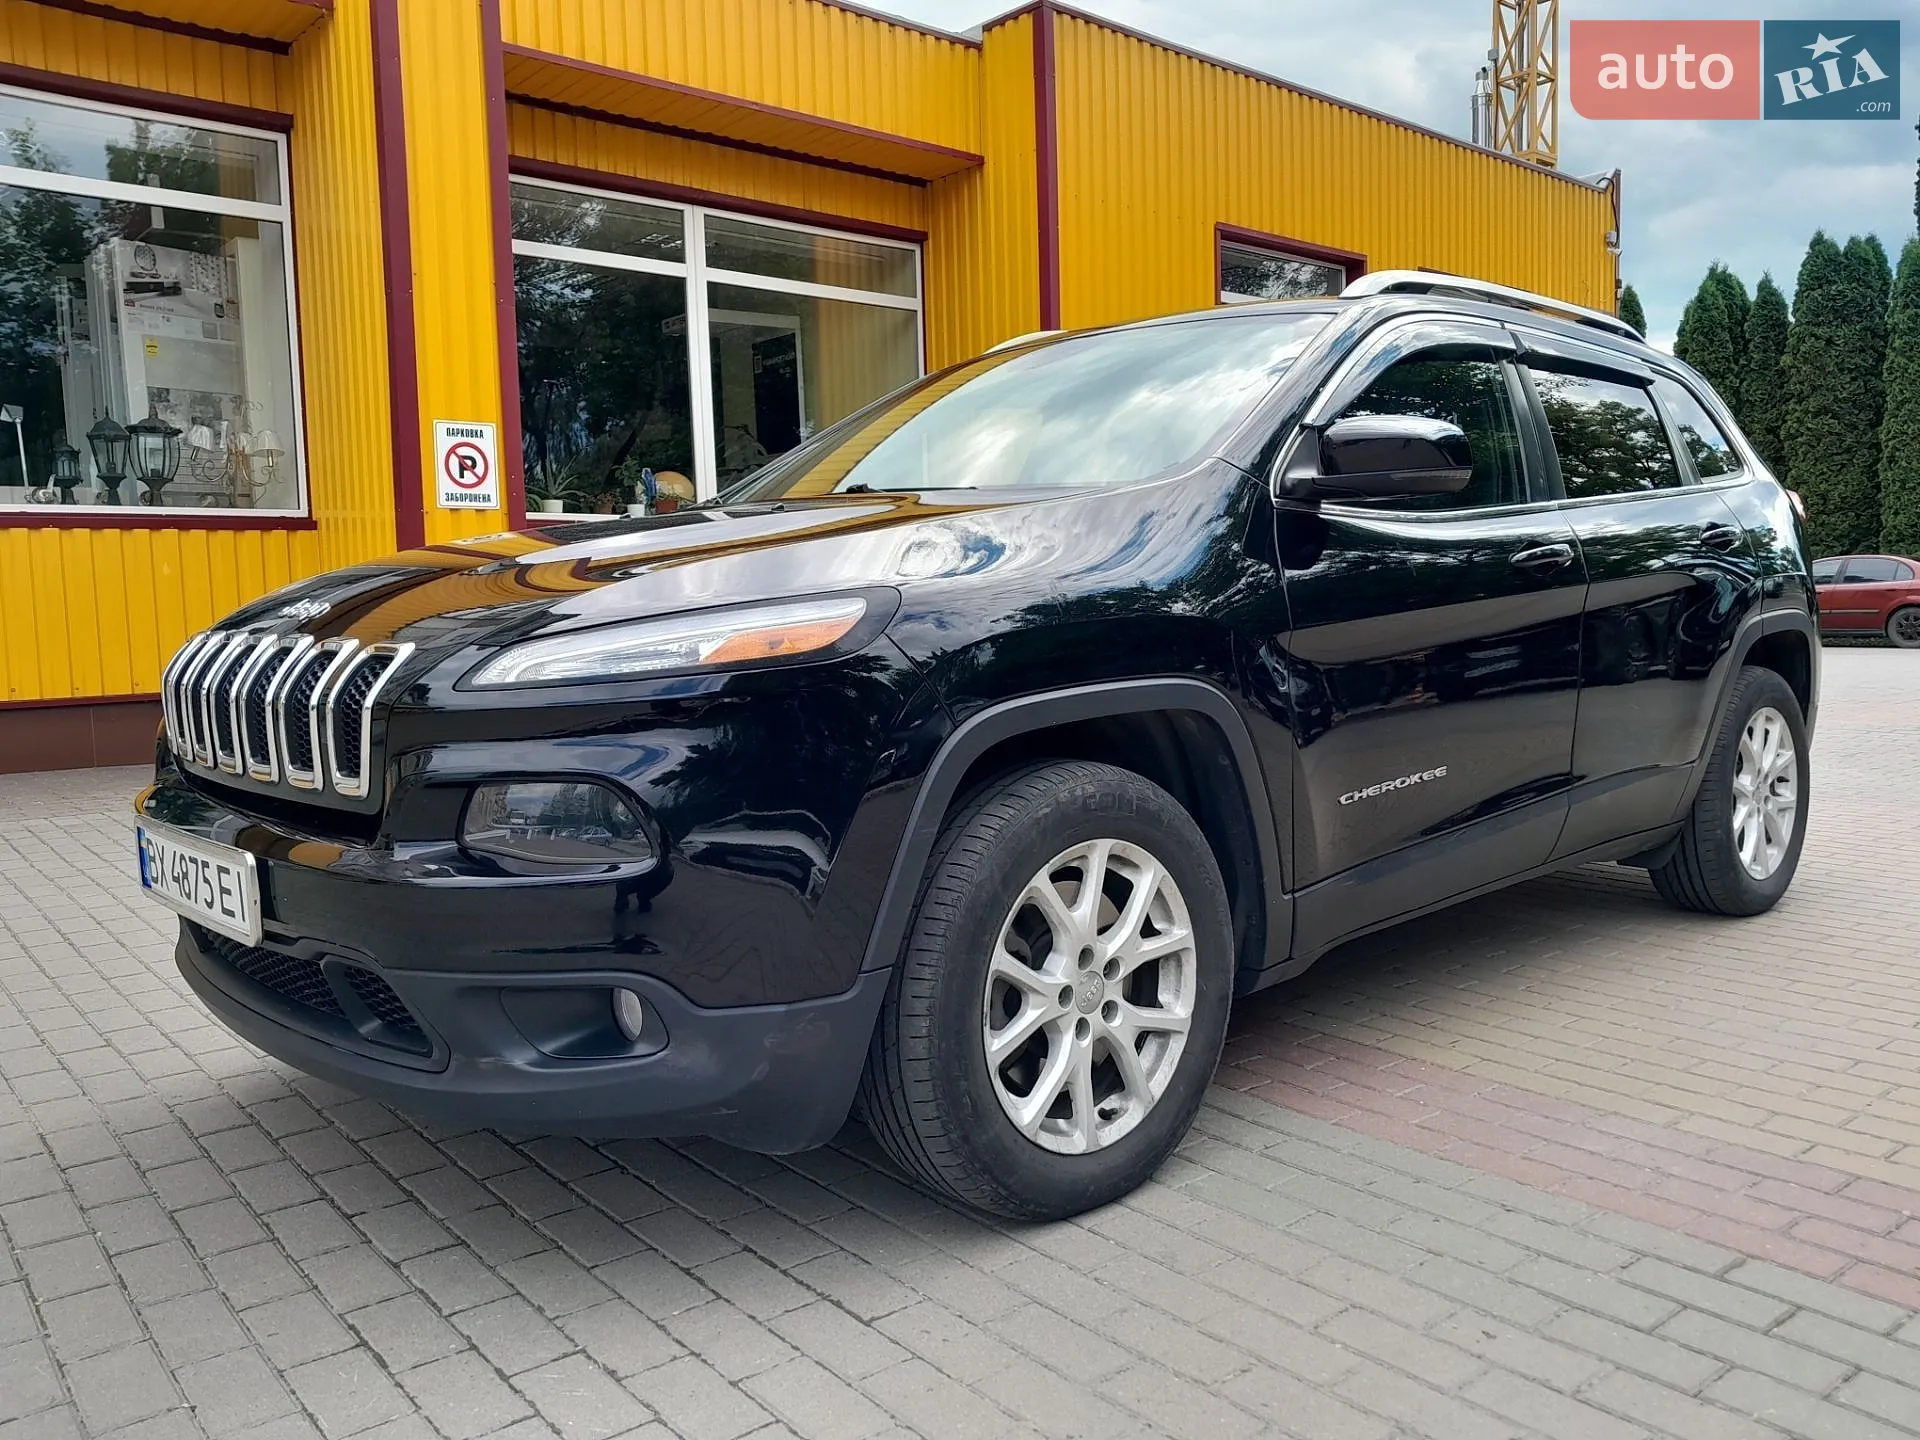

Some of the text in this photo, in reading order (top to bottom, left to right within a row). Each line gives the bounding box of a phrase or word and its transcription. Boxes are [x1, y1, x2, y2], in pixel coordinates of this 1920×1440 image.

[446, 427, 484, 439] ПАРКОВКА
[445, 492, 492, 504] ЗАБОРОНЕНА
[1339, 765, 1448, 805] CHEROKEE
